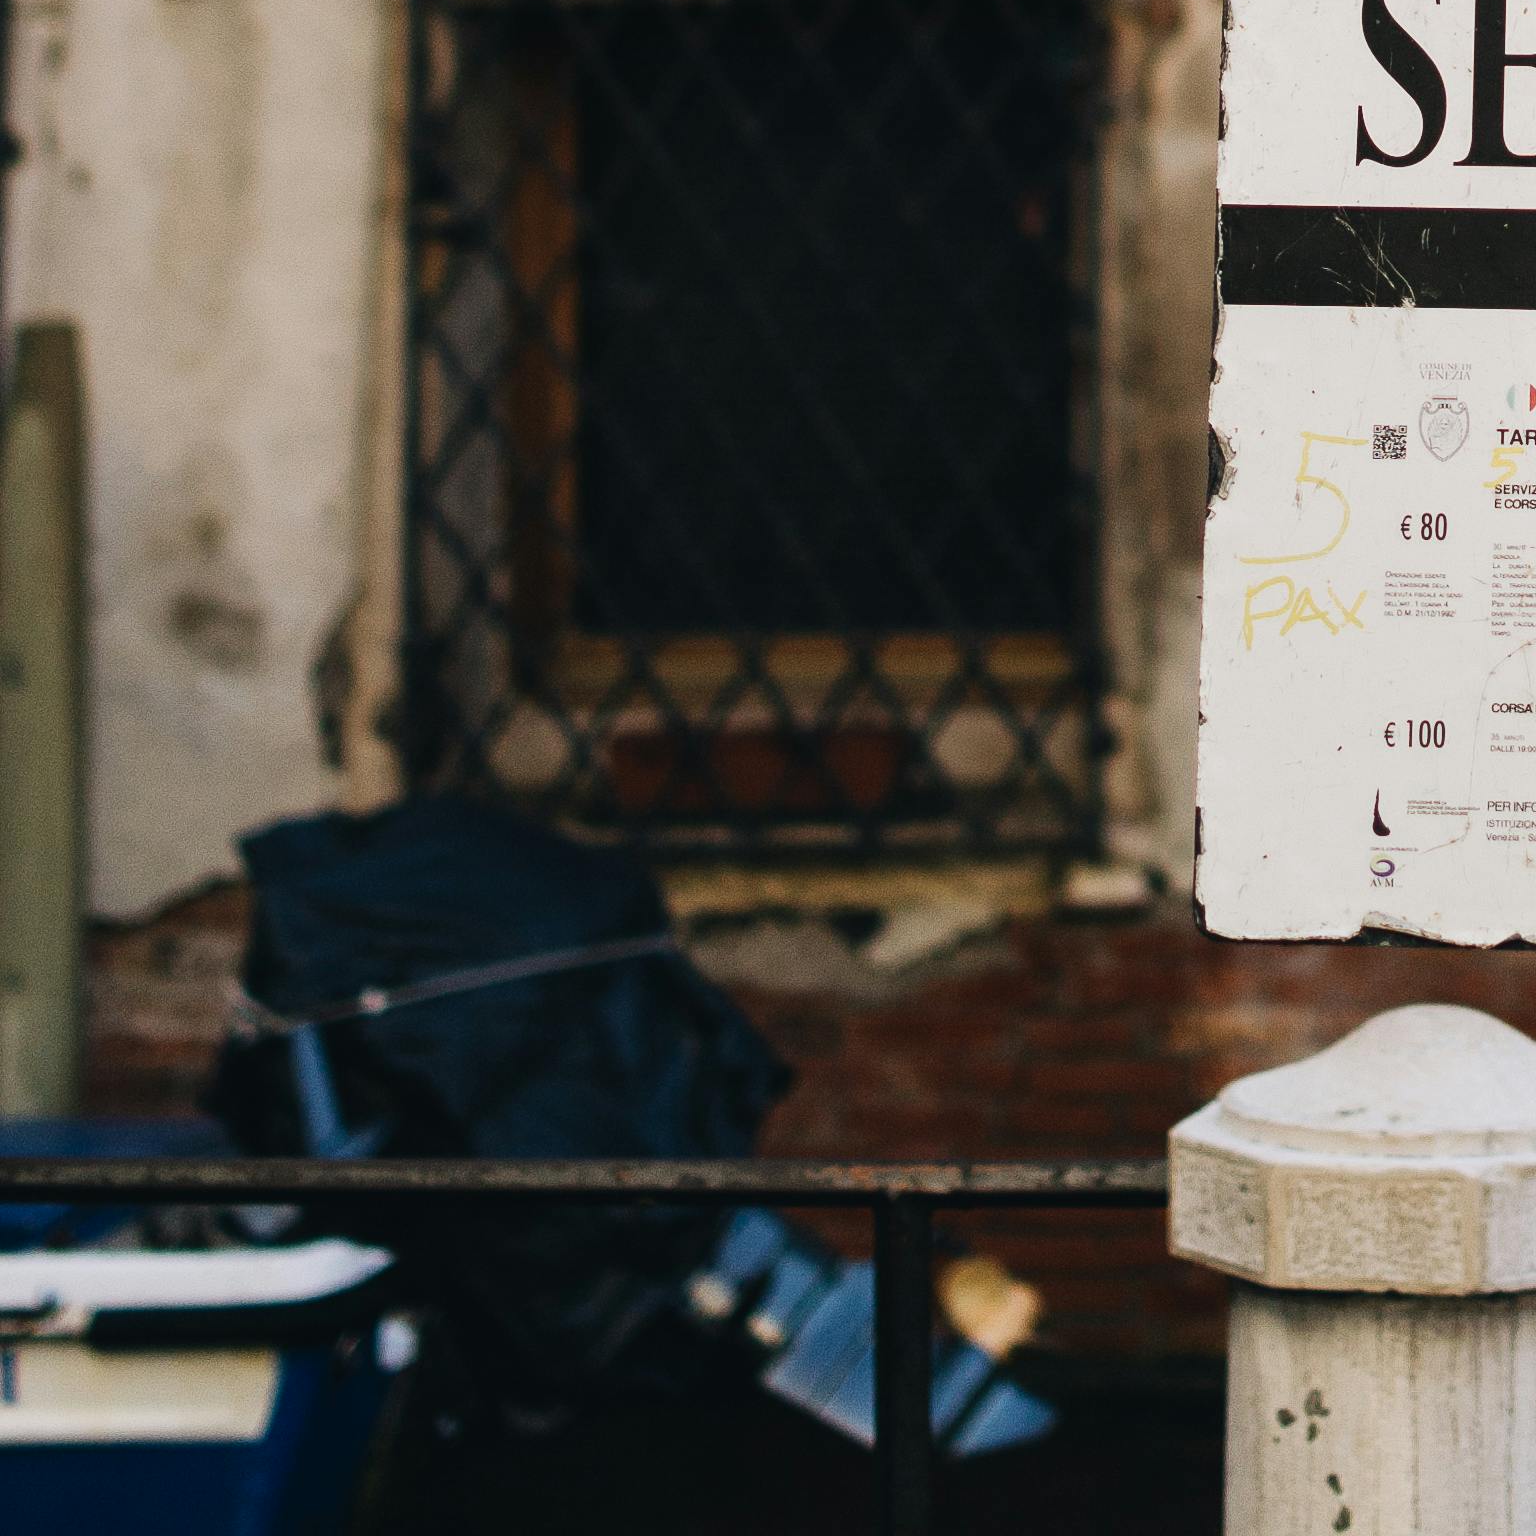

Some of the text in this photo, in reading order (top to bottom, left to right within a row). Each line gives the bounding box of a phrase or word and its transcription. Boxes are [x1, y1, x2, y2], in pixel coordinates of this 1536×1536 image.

[1419, 362, 1458, 370] COMUNE
[1420, 370, 1471, 381] VENEZIA
[1482, 447, 1525, 488] 5
[1239, 431, 1369, 564] 5
[1494, 498, 1502, 508] E
[1401, 512, 1448, 541] € 80
[1242, 575, 1368, 652] PAX
[1491, 703, 1532, 714] CORSA
[1384, 719, 1446, 748] € 100
[1490, 744, 1515, 752] DALLE
[1487, 801, 1511, 811] PER
[1486, 834, 1519, 842] Venezia
[1370, 878, 1394, 888] AVM
